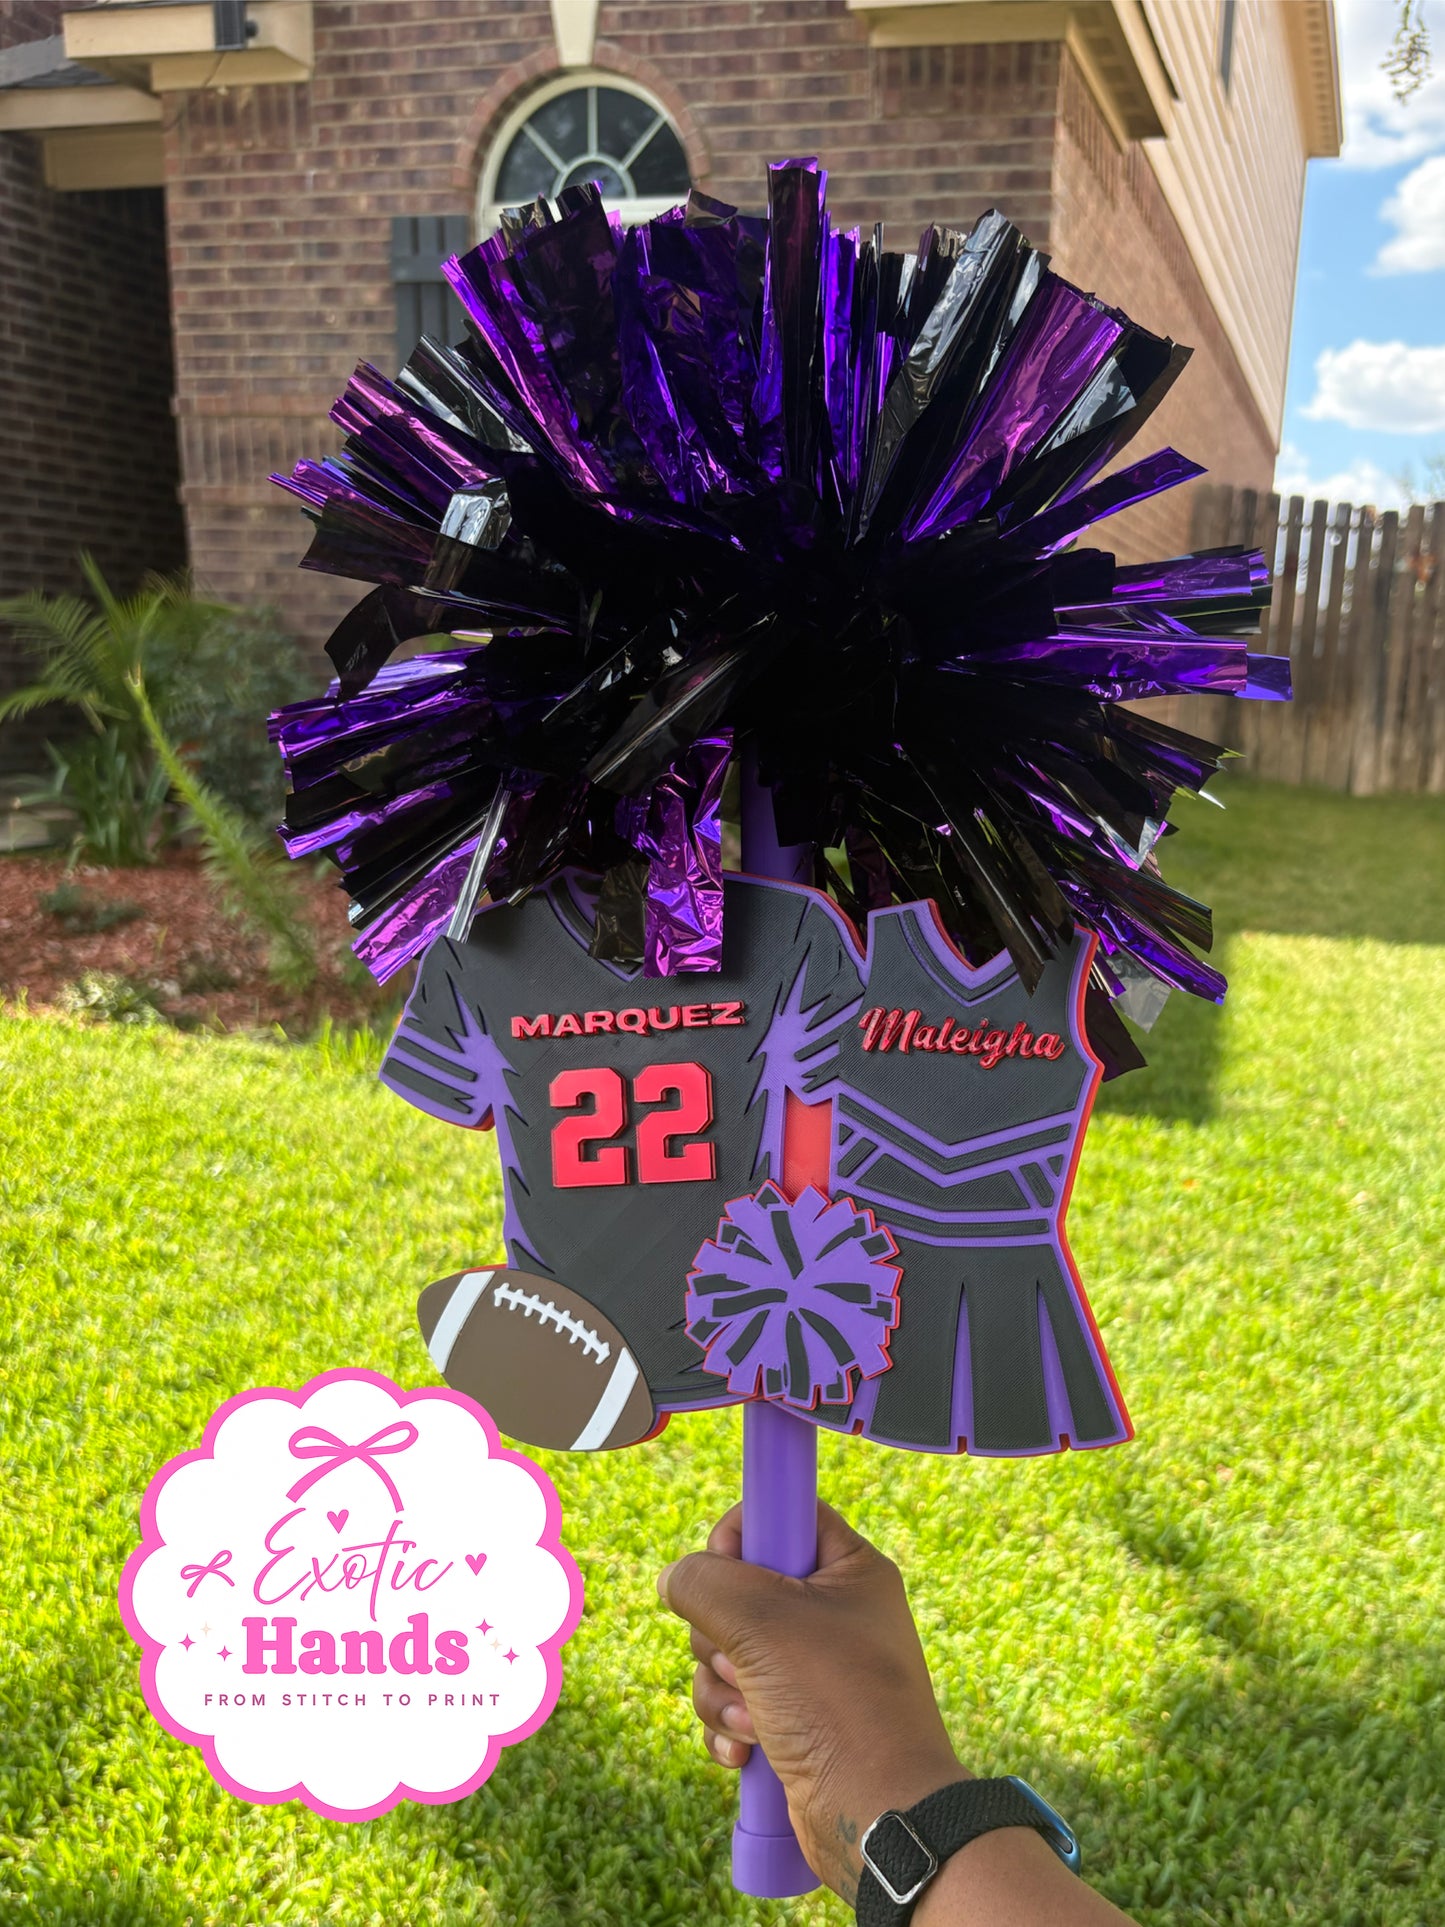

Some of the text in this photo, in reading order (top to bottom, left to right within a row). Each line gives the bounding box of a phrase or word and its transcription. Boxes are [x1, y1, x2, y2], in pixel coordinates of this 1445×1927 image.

[510, 1000, 745, 1040] MARQUEZ
[858, 1006, 1065, 1069] Maleigha
[549, 1061, 716, 1188] 22
